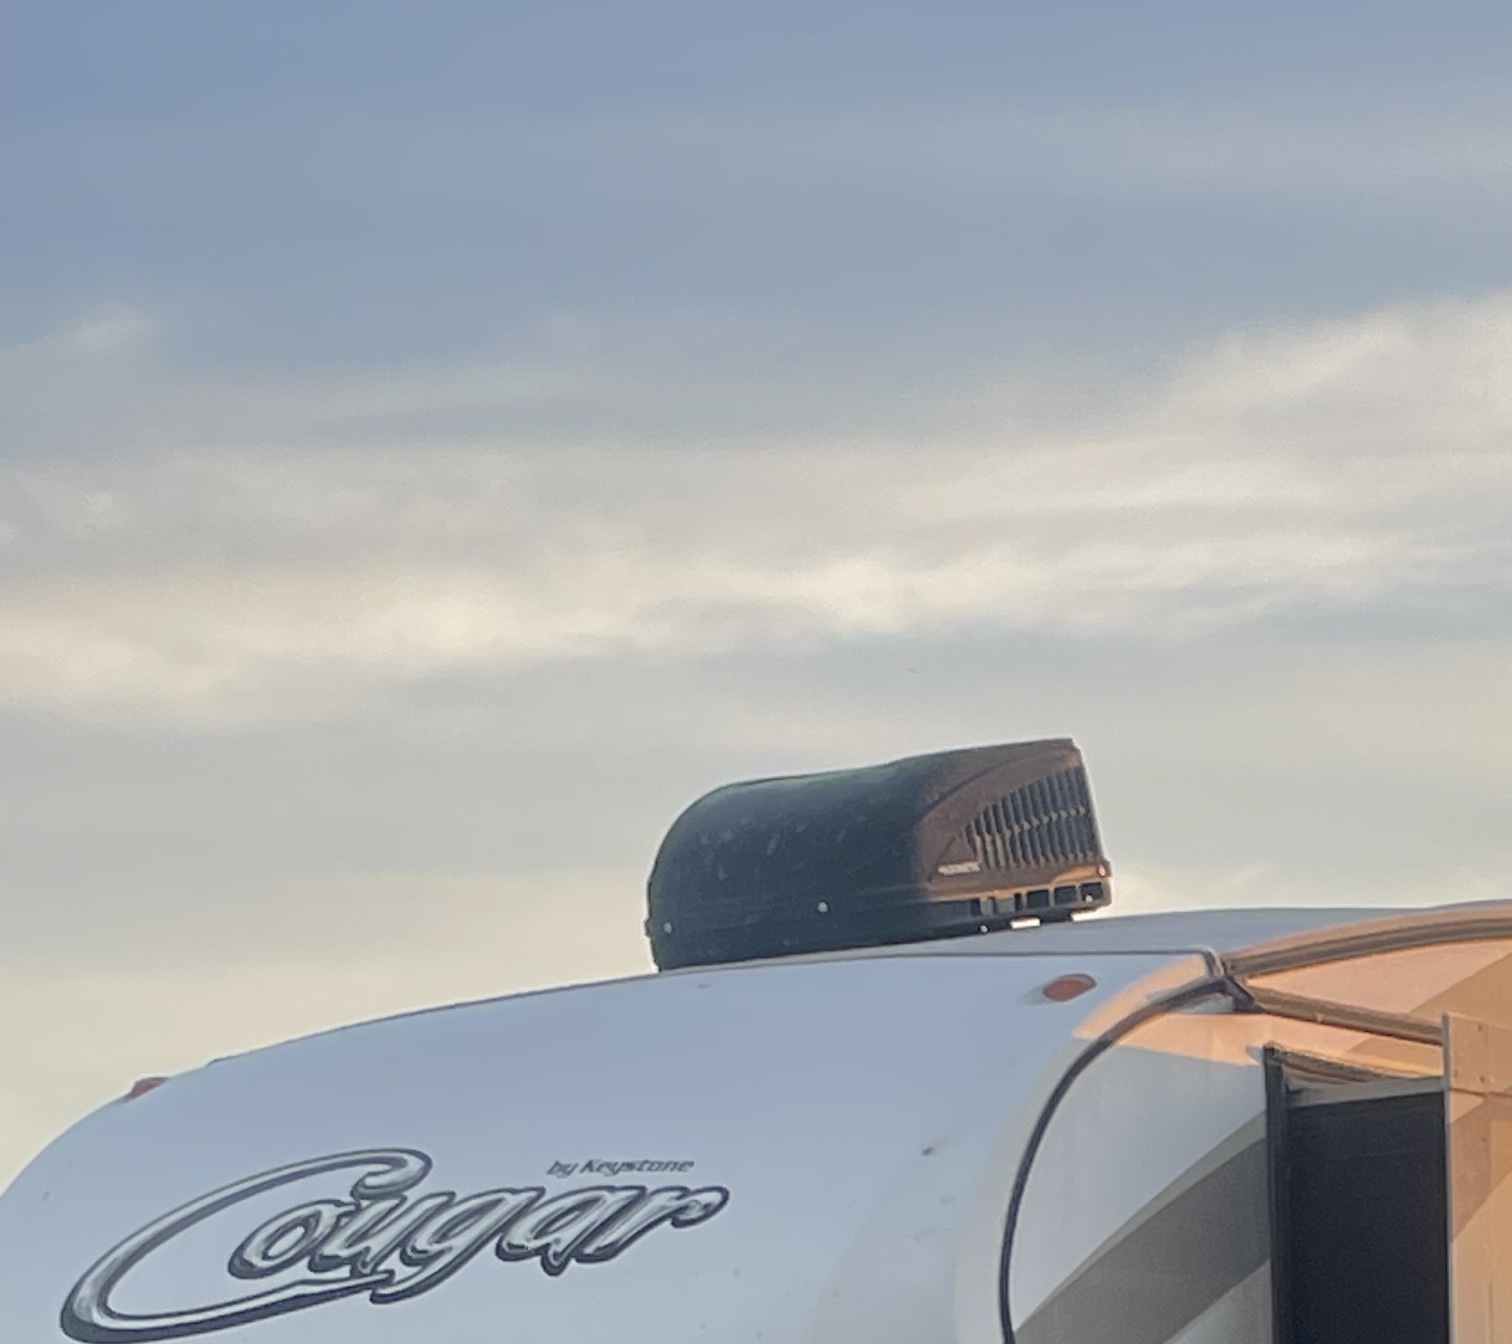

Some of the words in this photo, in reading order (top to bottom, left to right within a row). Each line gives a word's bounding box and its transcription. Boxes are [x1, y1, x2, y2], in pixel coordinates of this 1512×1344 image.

[546, 1160, 579, 1179] by
[580, 1158, 695, 1177] Keystone
[60, 1147, 729, 1344] Cougar
